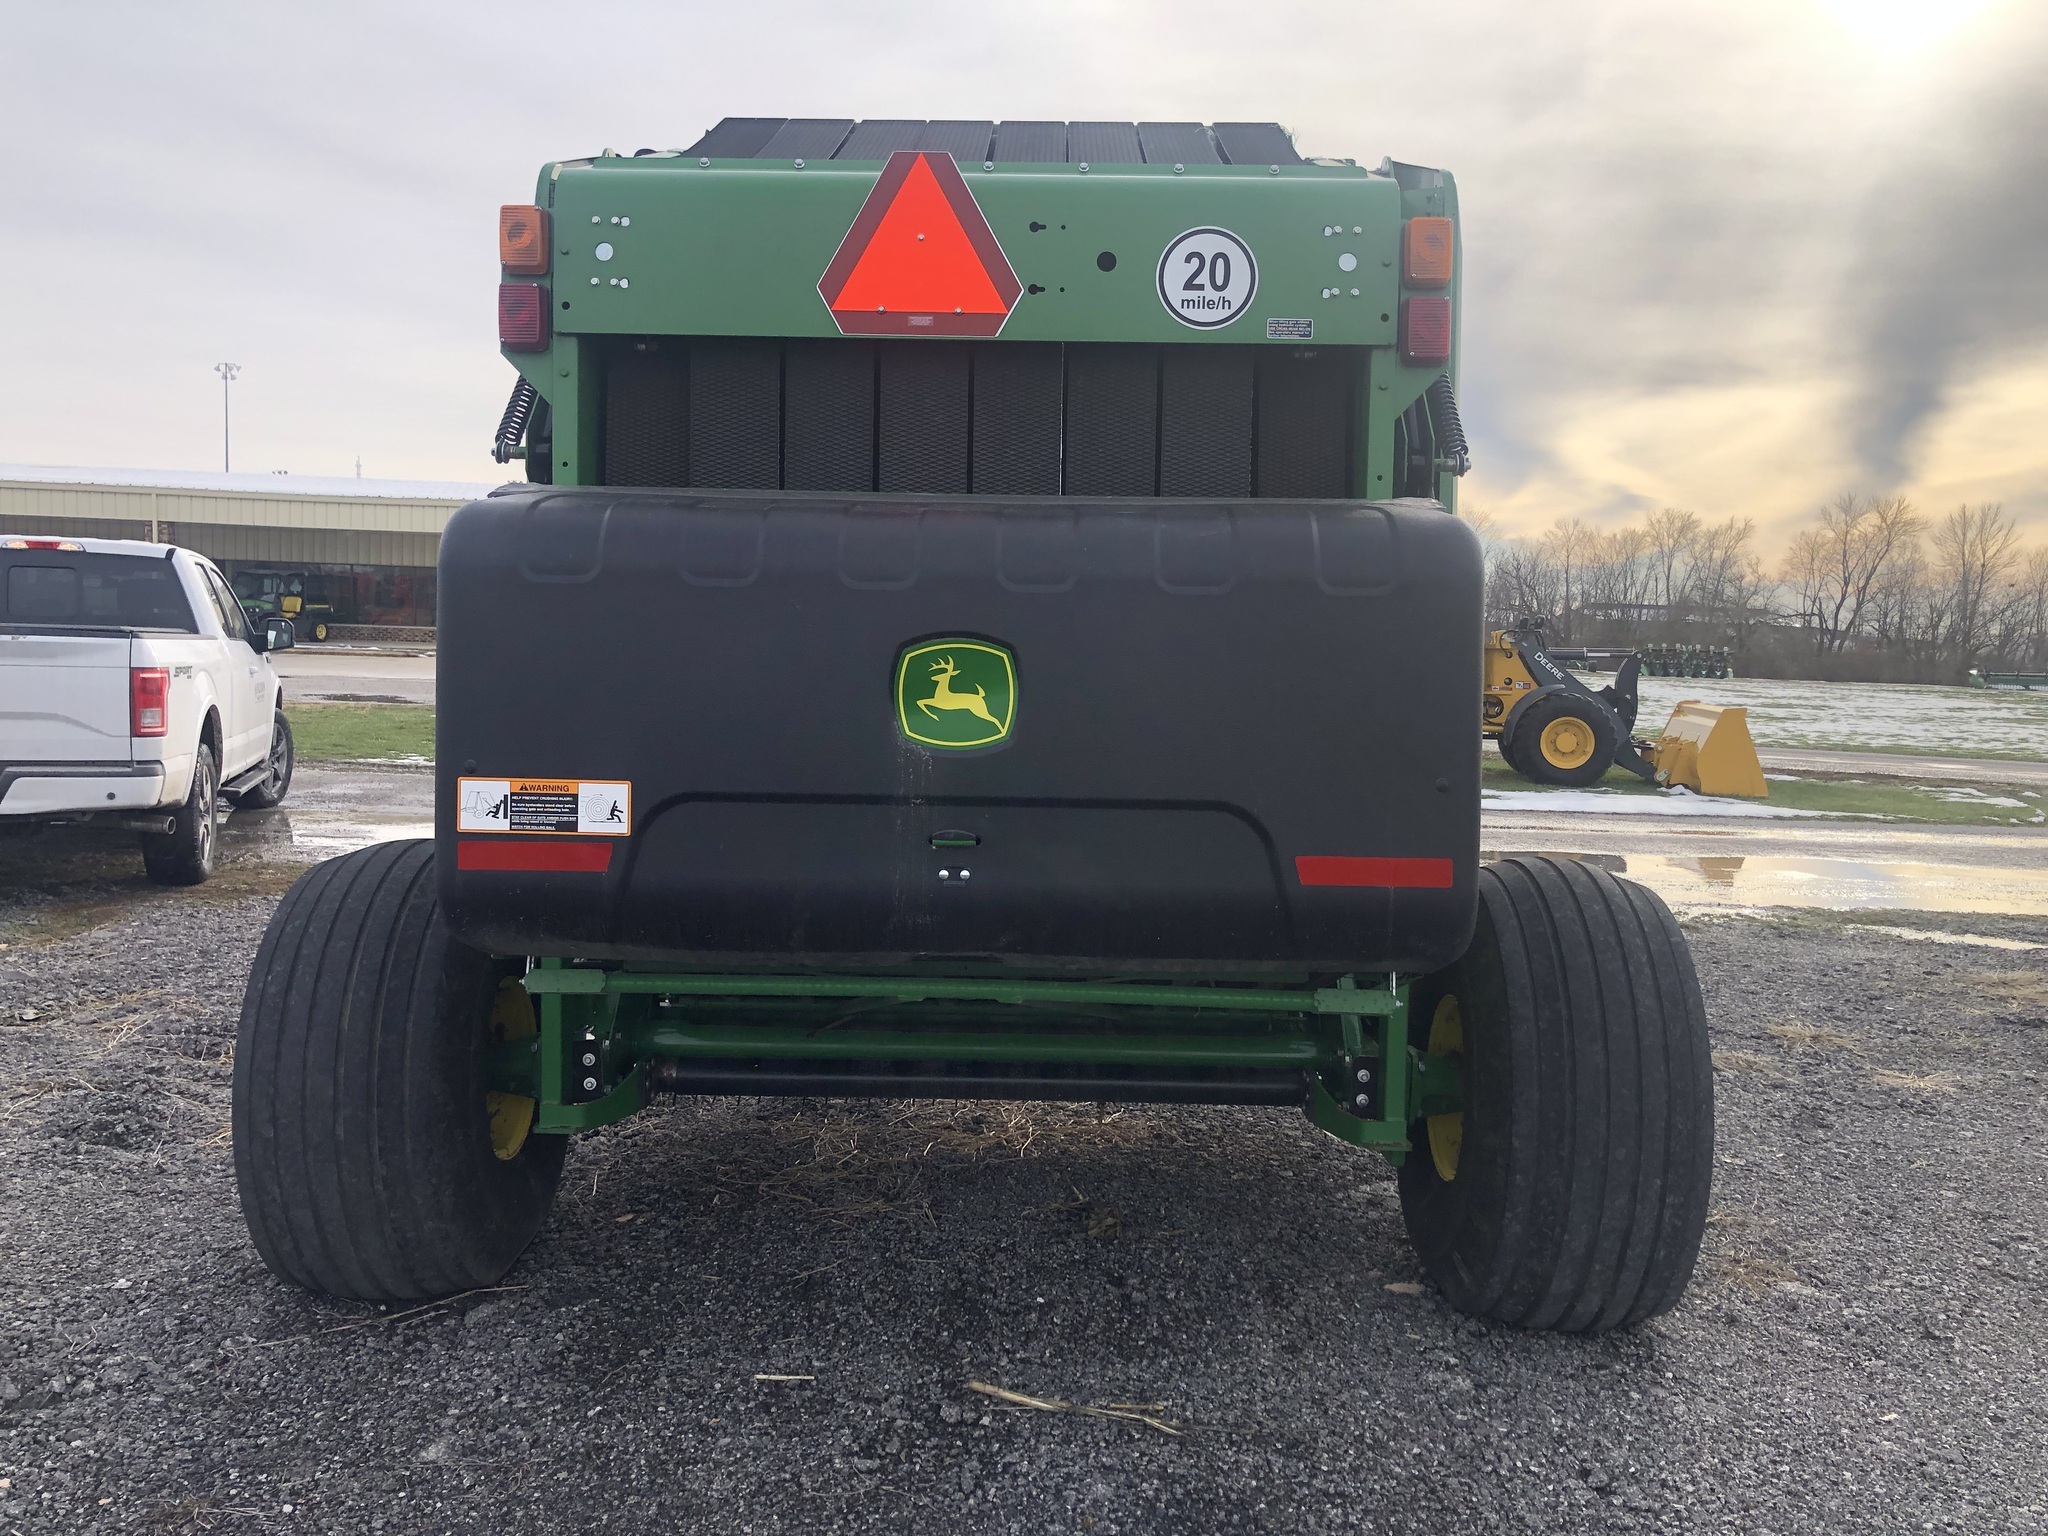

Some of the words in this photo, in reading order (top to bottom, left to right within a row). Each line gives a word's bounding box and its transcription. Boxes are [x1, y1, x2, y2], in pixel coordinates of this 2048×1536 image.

[1182, 251, 1231, 292] 20
[1180, 296, 1231, 310] mile/h
[1533, 651, 1565, 681] DEERE
